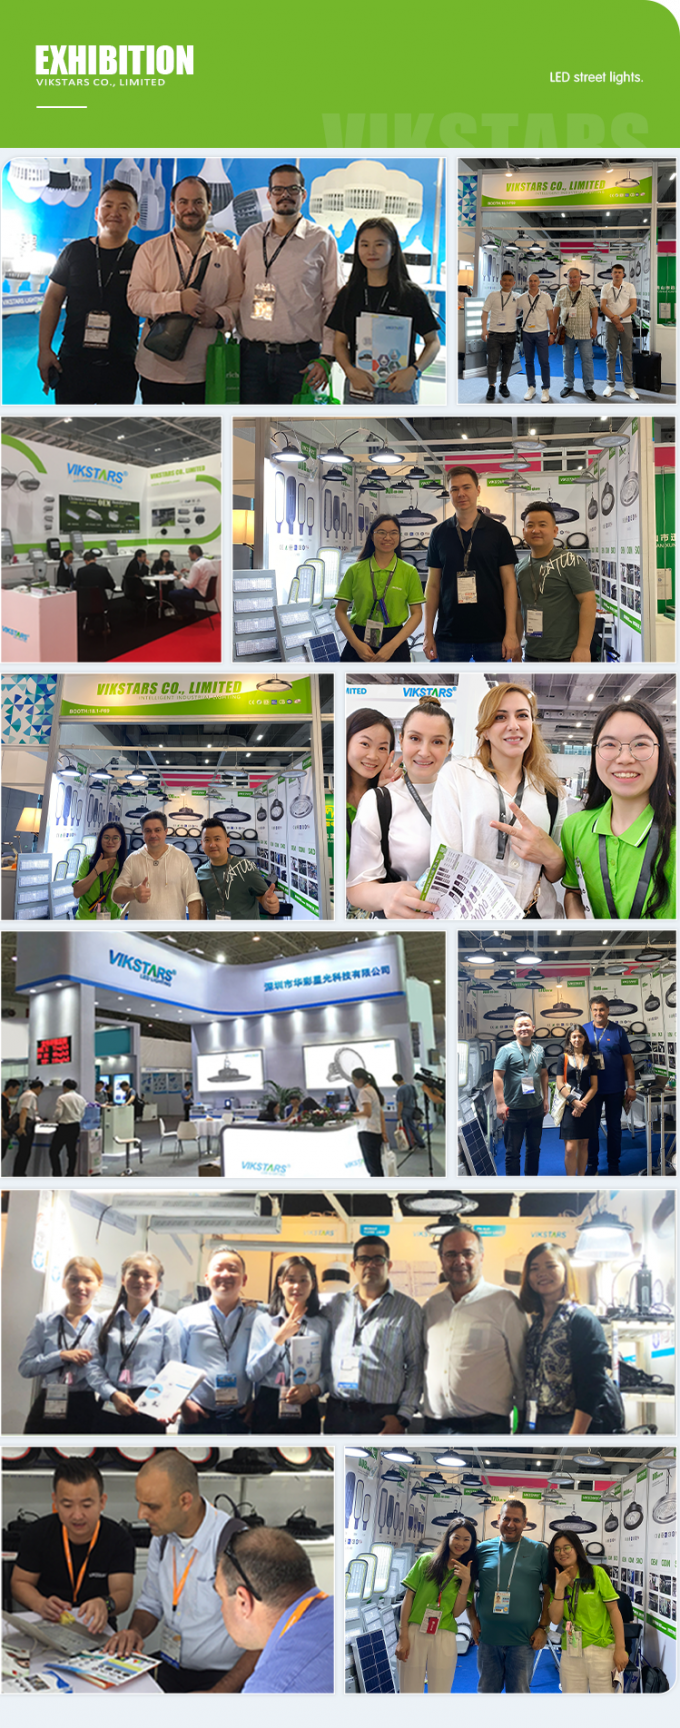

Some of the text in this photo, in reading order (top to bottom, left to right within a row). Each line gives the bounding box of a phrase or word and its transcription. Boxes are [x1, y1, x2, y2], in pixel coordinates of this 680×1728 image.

[505, 179, 606, 193] VIKSTARS CO., LIMITED
[67, 462, 125, 484] VIKSTARS
[96, 680, 243, 696] VIKSTARS CO., LIMITED
[402, 687, 453, 698] VIKSTARS
[109, 949, 172, 982] VIKSTARS
[241, 1161, 288, 1174] VIKSTARS
[530, 1230, 568, 1239] VIKSTARS
